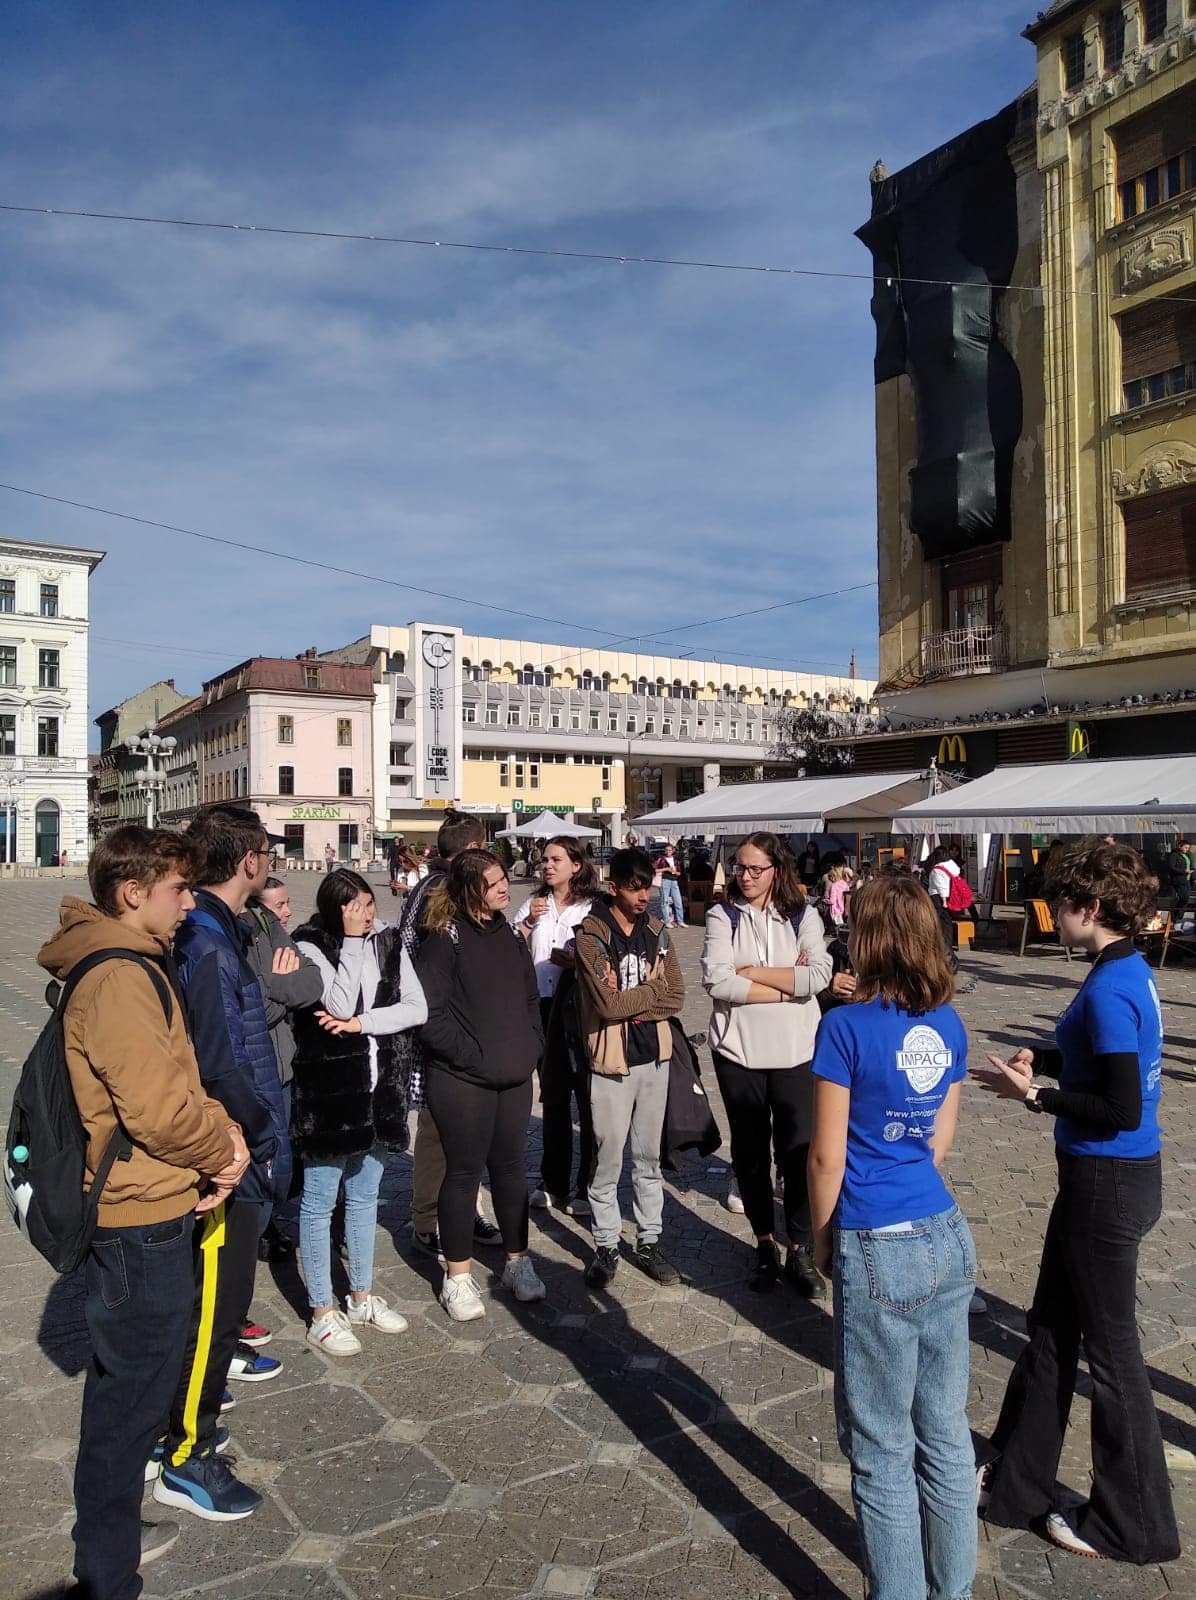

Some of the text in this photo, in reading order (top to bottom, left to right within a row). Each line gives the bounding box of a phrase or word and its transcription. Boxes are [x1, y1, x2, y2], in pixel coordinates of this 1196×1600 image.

[435, 757, 444, 766] DE
[292, 807, 341, 818] SPARTAN
[901, 1052, 950, 1067] IMPACT
